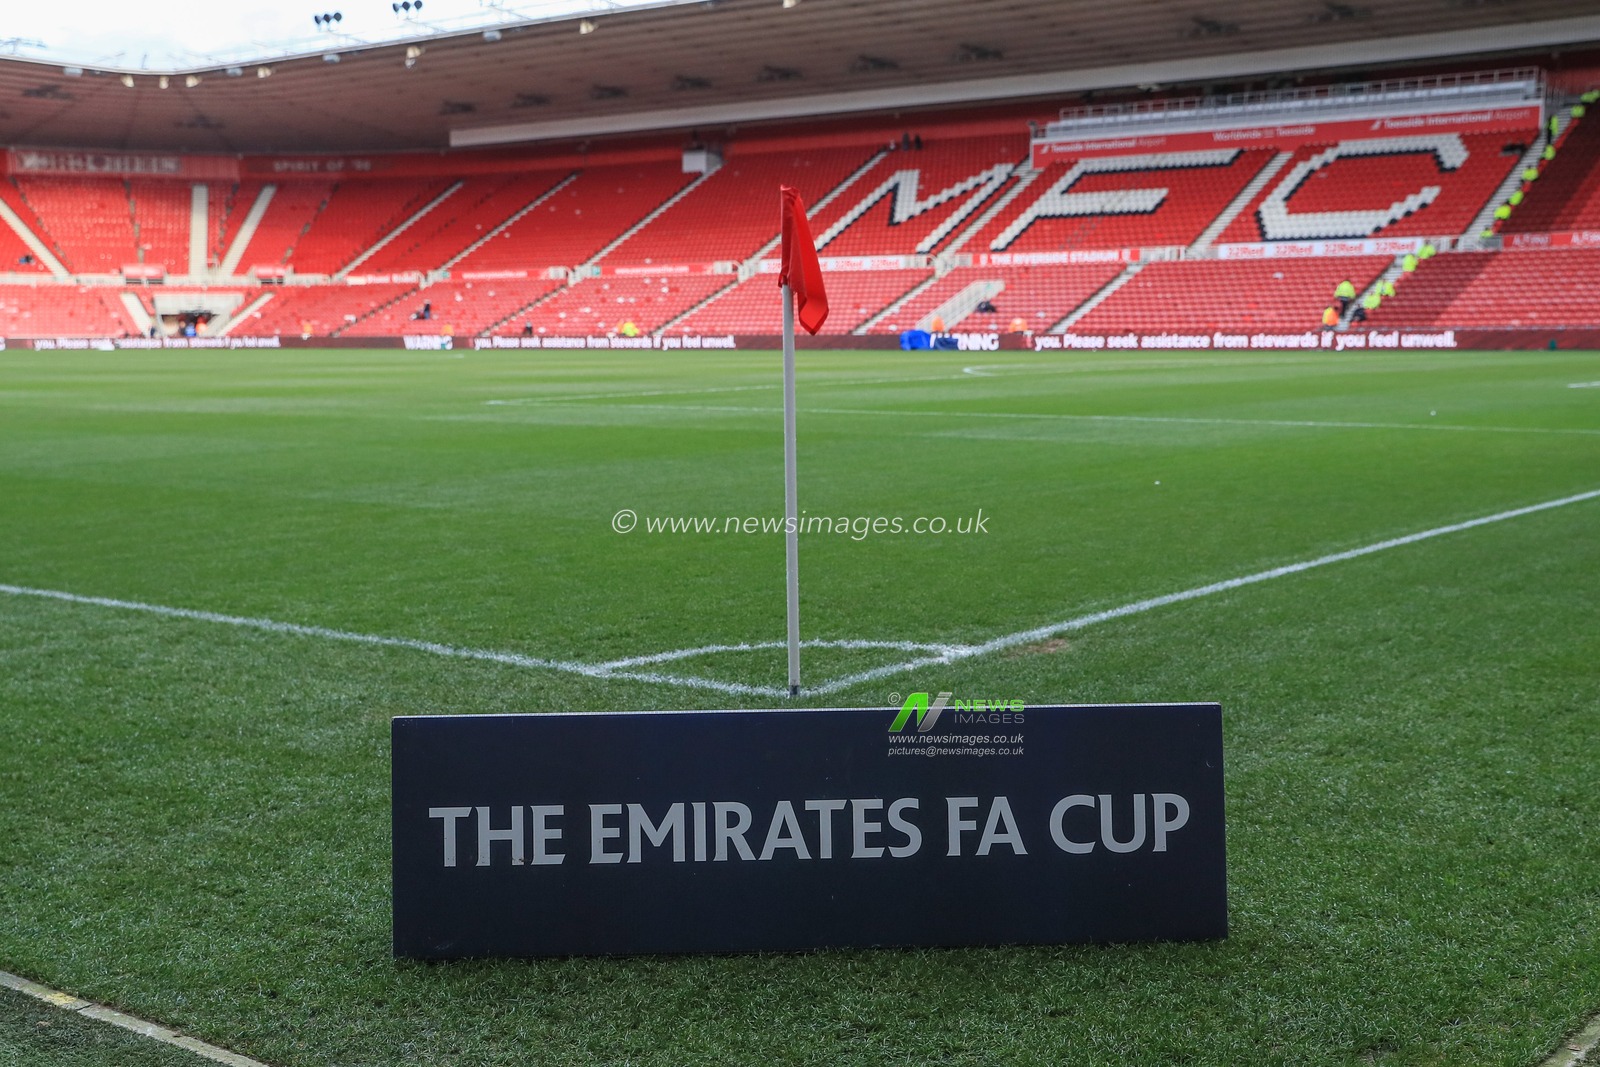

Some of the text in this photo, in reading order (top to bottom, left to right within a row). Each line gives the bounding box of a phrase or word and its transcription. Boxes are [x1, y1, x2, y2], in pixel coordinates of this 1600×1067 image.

[1063, 334, 1105, 348] Please
[1106, 332, 1139, 348] seek
[1141, 332, 1211, 348] assistance
[1213, 331, 1249, 348] from
[1250, 333, 1319, 348] stewards
[1320, 331, 1334, 348] if
[1335, 334, 1366, 351] you
[1368, 331, 1399, 347] feel
[428, 792, 1191, 868] THE EMIRATES FA CUP
